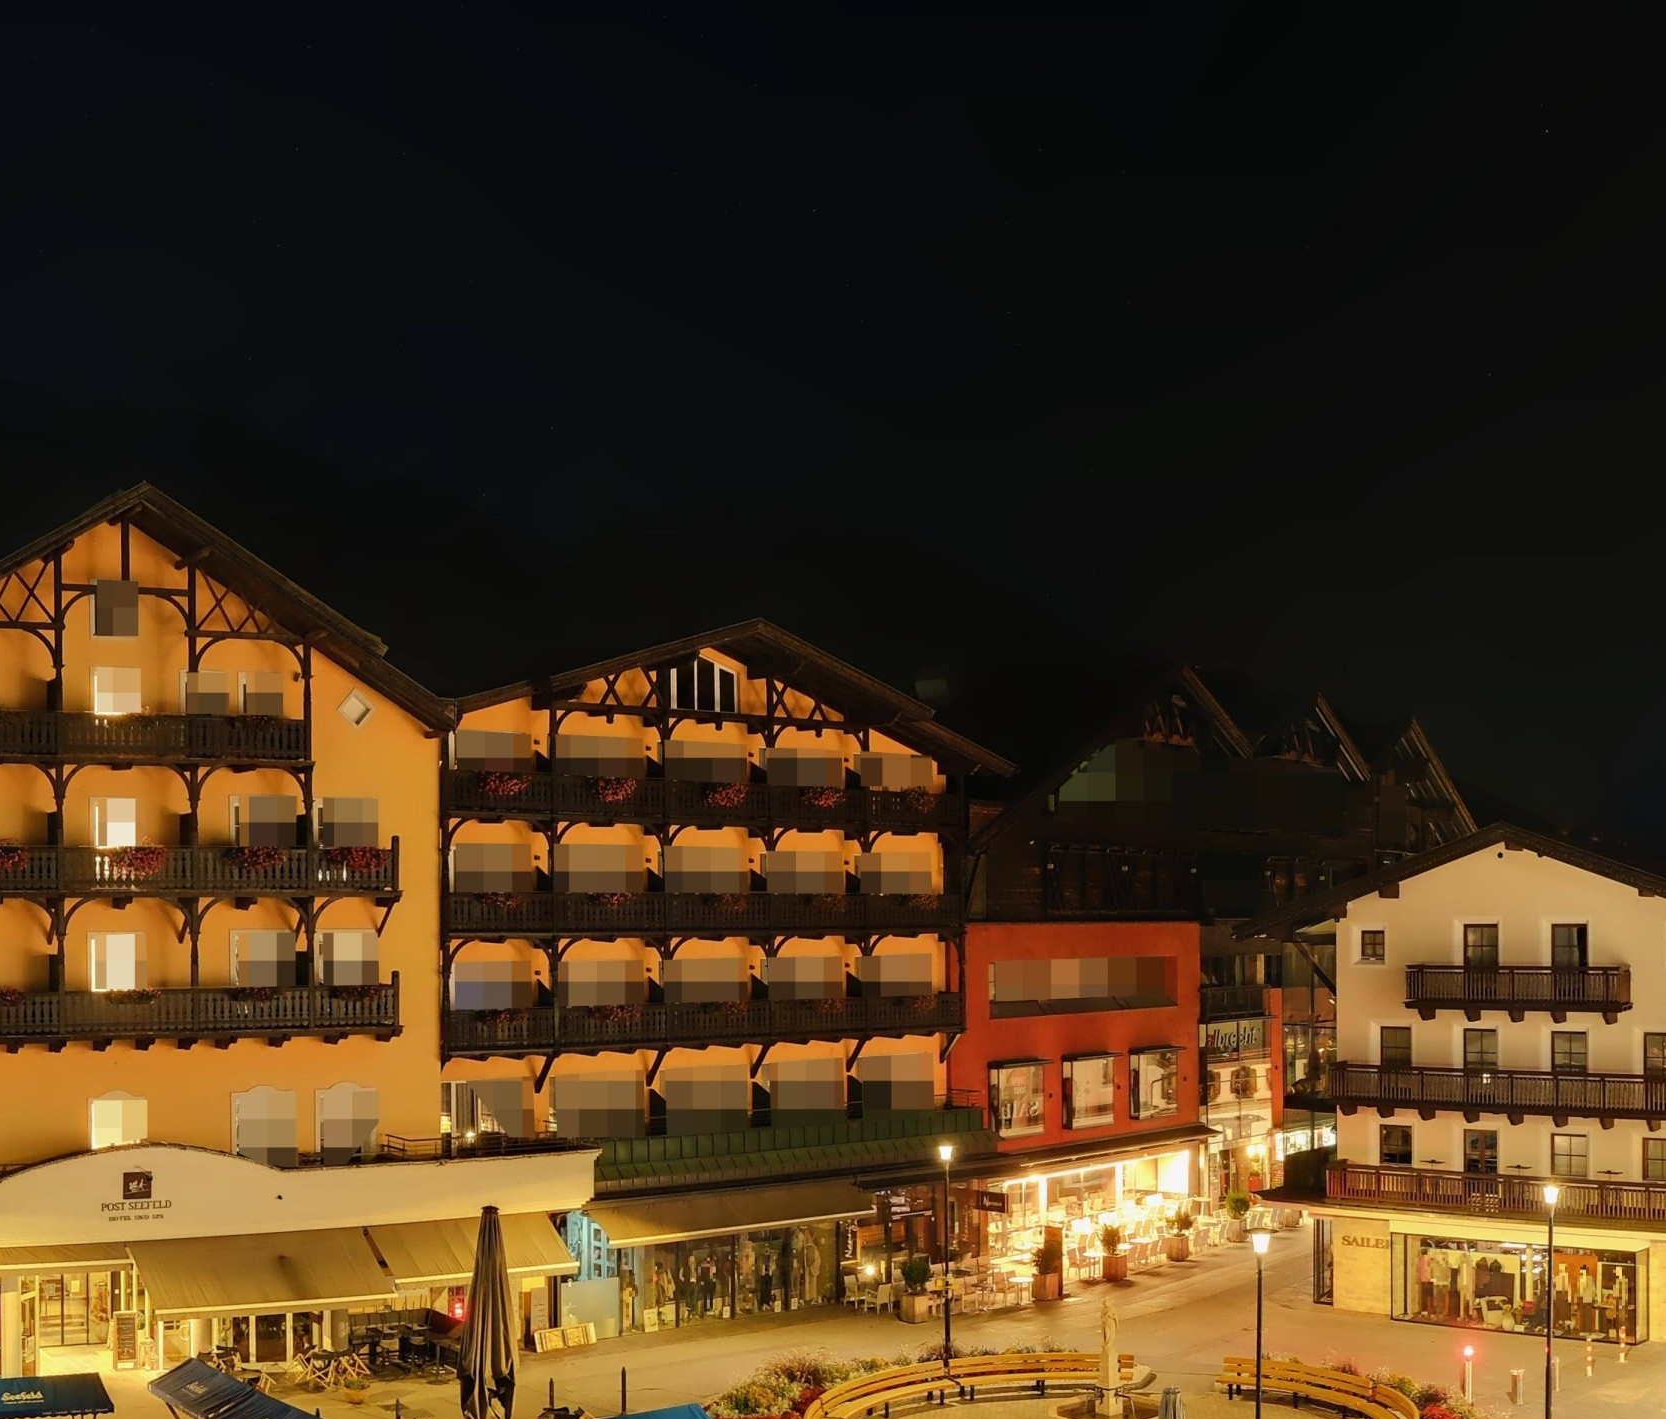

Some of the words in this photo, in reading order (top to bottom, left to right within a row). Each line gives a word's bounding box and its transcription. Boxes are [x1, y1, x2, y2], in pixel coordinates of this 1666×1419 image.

[101, 1202, 127, 1212] POST
[128, 1199, 172, 1211] SEEFELD
[0, 1390, 44, 1402] Seefeld
